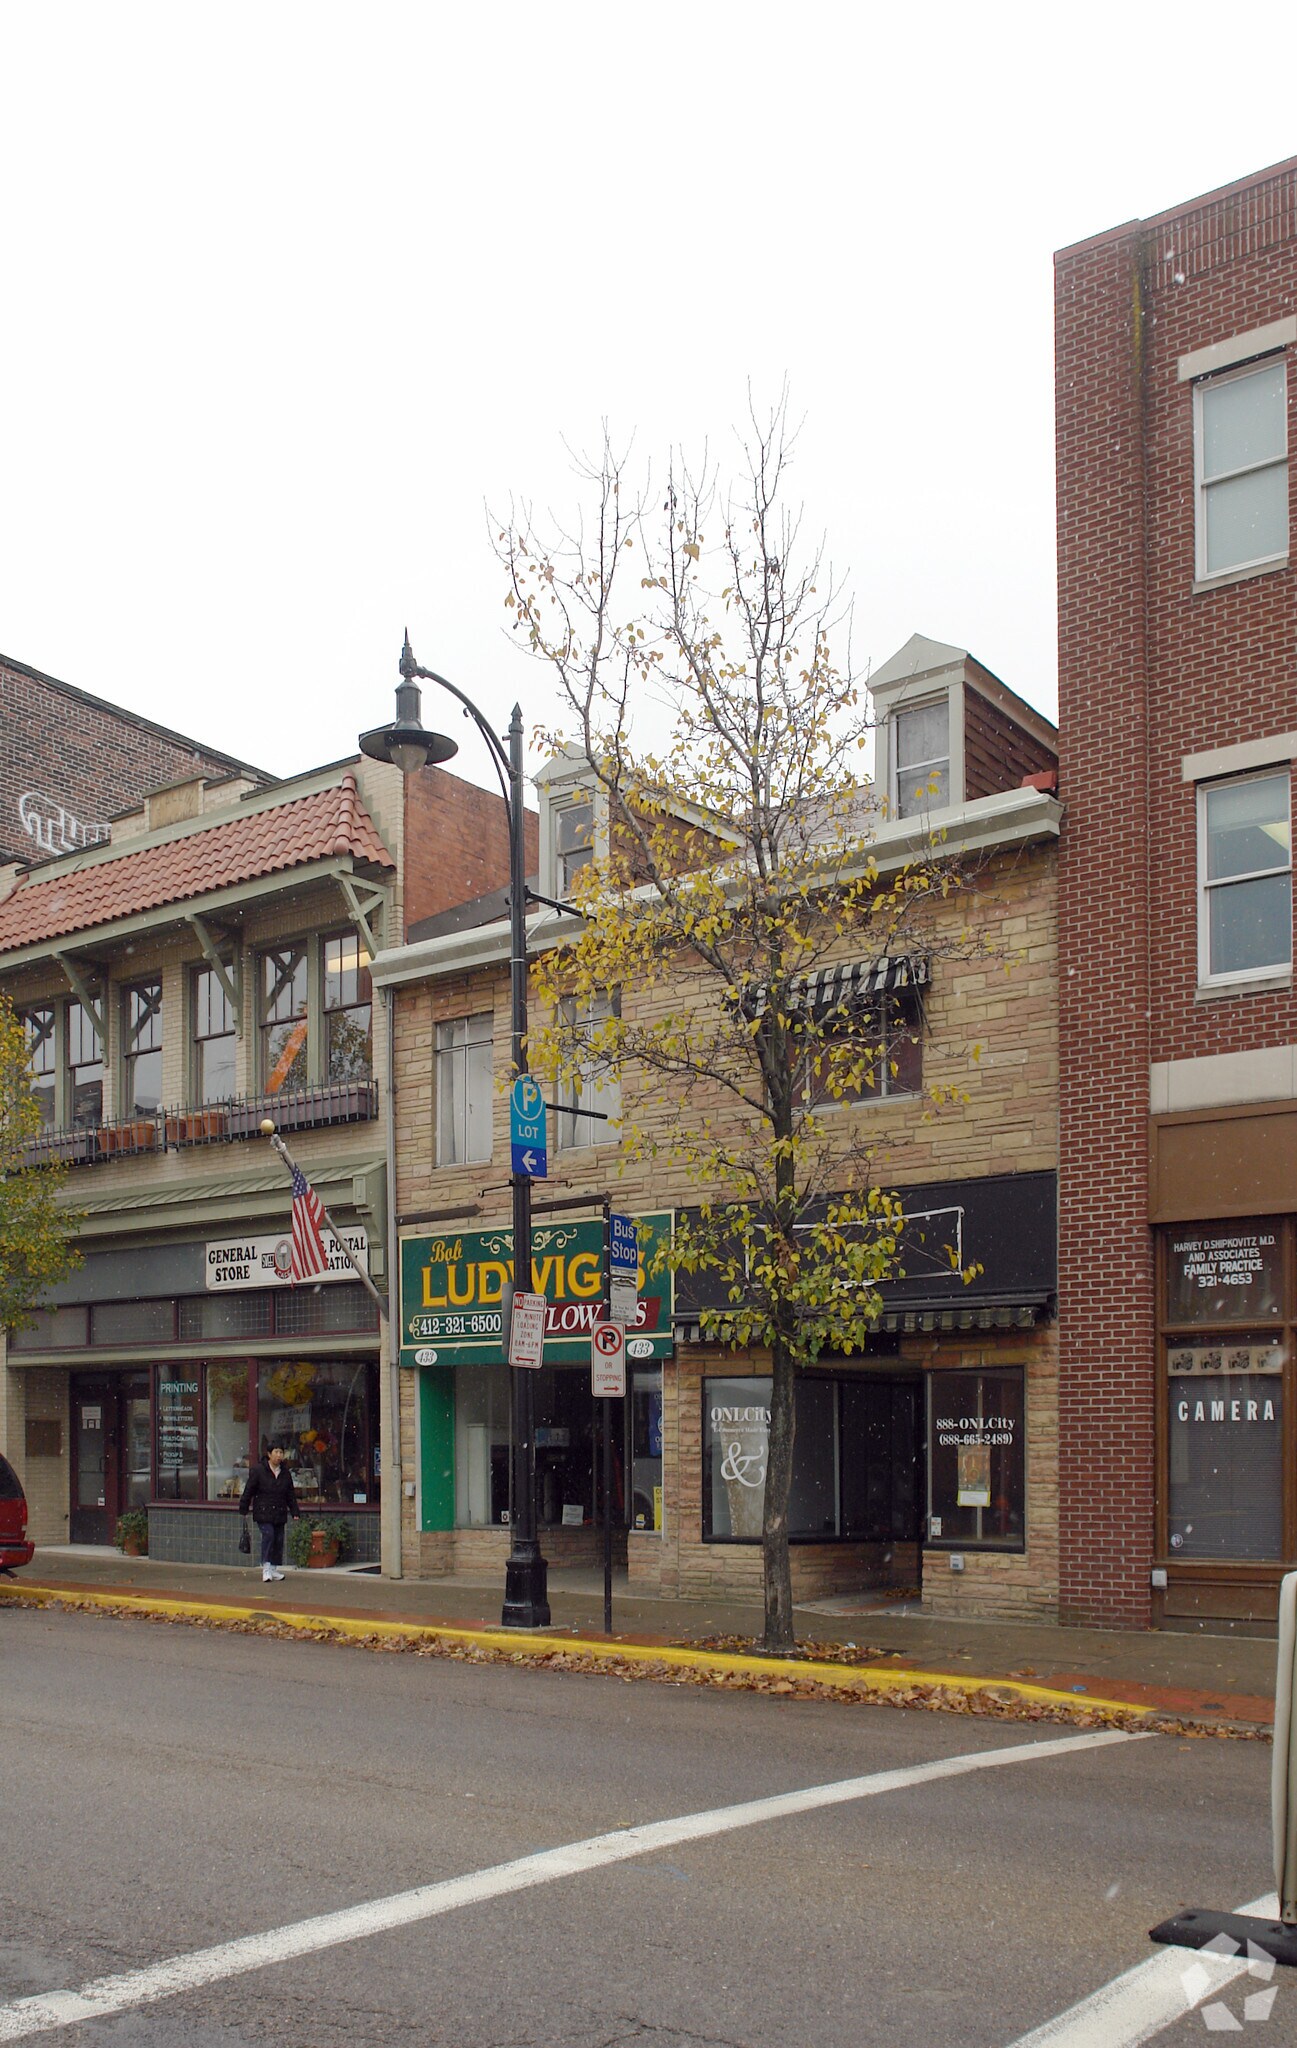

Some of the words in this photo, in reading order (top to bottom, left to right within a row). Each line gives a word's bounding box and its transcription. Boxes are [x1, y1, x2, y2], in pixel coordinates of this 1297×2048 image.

[518, 1124, 539, 1139] LOT
[614, 1220, 635, 1239] Bus
[330, 1237, 366, 1252] POTAL
[430, 1239, 463, 1263] Bob
[1174, 1241, 1202, 1252] HARVEY
[1260, 1235, 1276, 1245] M.D.
[208, 1246, 258, 1264] GENERAL
[612, 1241, 637, 1264] Stop
[1188, 1252, 1206, 1263] AND
[1208, 1248, 1260, 1261] ASSOCIATES
[215, 1265, 250, 1282] STORE
[1184, 1262, 1217, 1276] FAMILY
[1220, 1259, 1263, 1273] PRACTICE
[422, 1251, 646, 1307] LUDWIG
[514, 1296, 523, 1307] NO
[524, 1298, 544, 1308] PARKING
[524, 1313, 542, 1322] MINUTE
[545, 1301, 648, 1331] LOWS
[420, 1314, 501, 1335] 412-321-6500
[517, 1321, 539, 1330] LOADING
[520, 1331, 534, 1340] ZONE
[631, 1342, 650, 1355] 433
[419, 1351, 435, 1363] 433
[604, 1361, 613, 1369] OR
[596, 1373, 622, 1382] STOPPING
[160, 1383, 199, 1393] PRINTING
[711, 1406, 772, 1424] ONLCity
[1178, 1400, 1275, 1421] CAMERA
[939, 1432, 1013, 1446] (888-665-2489)
